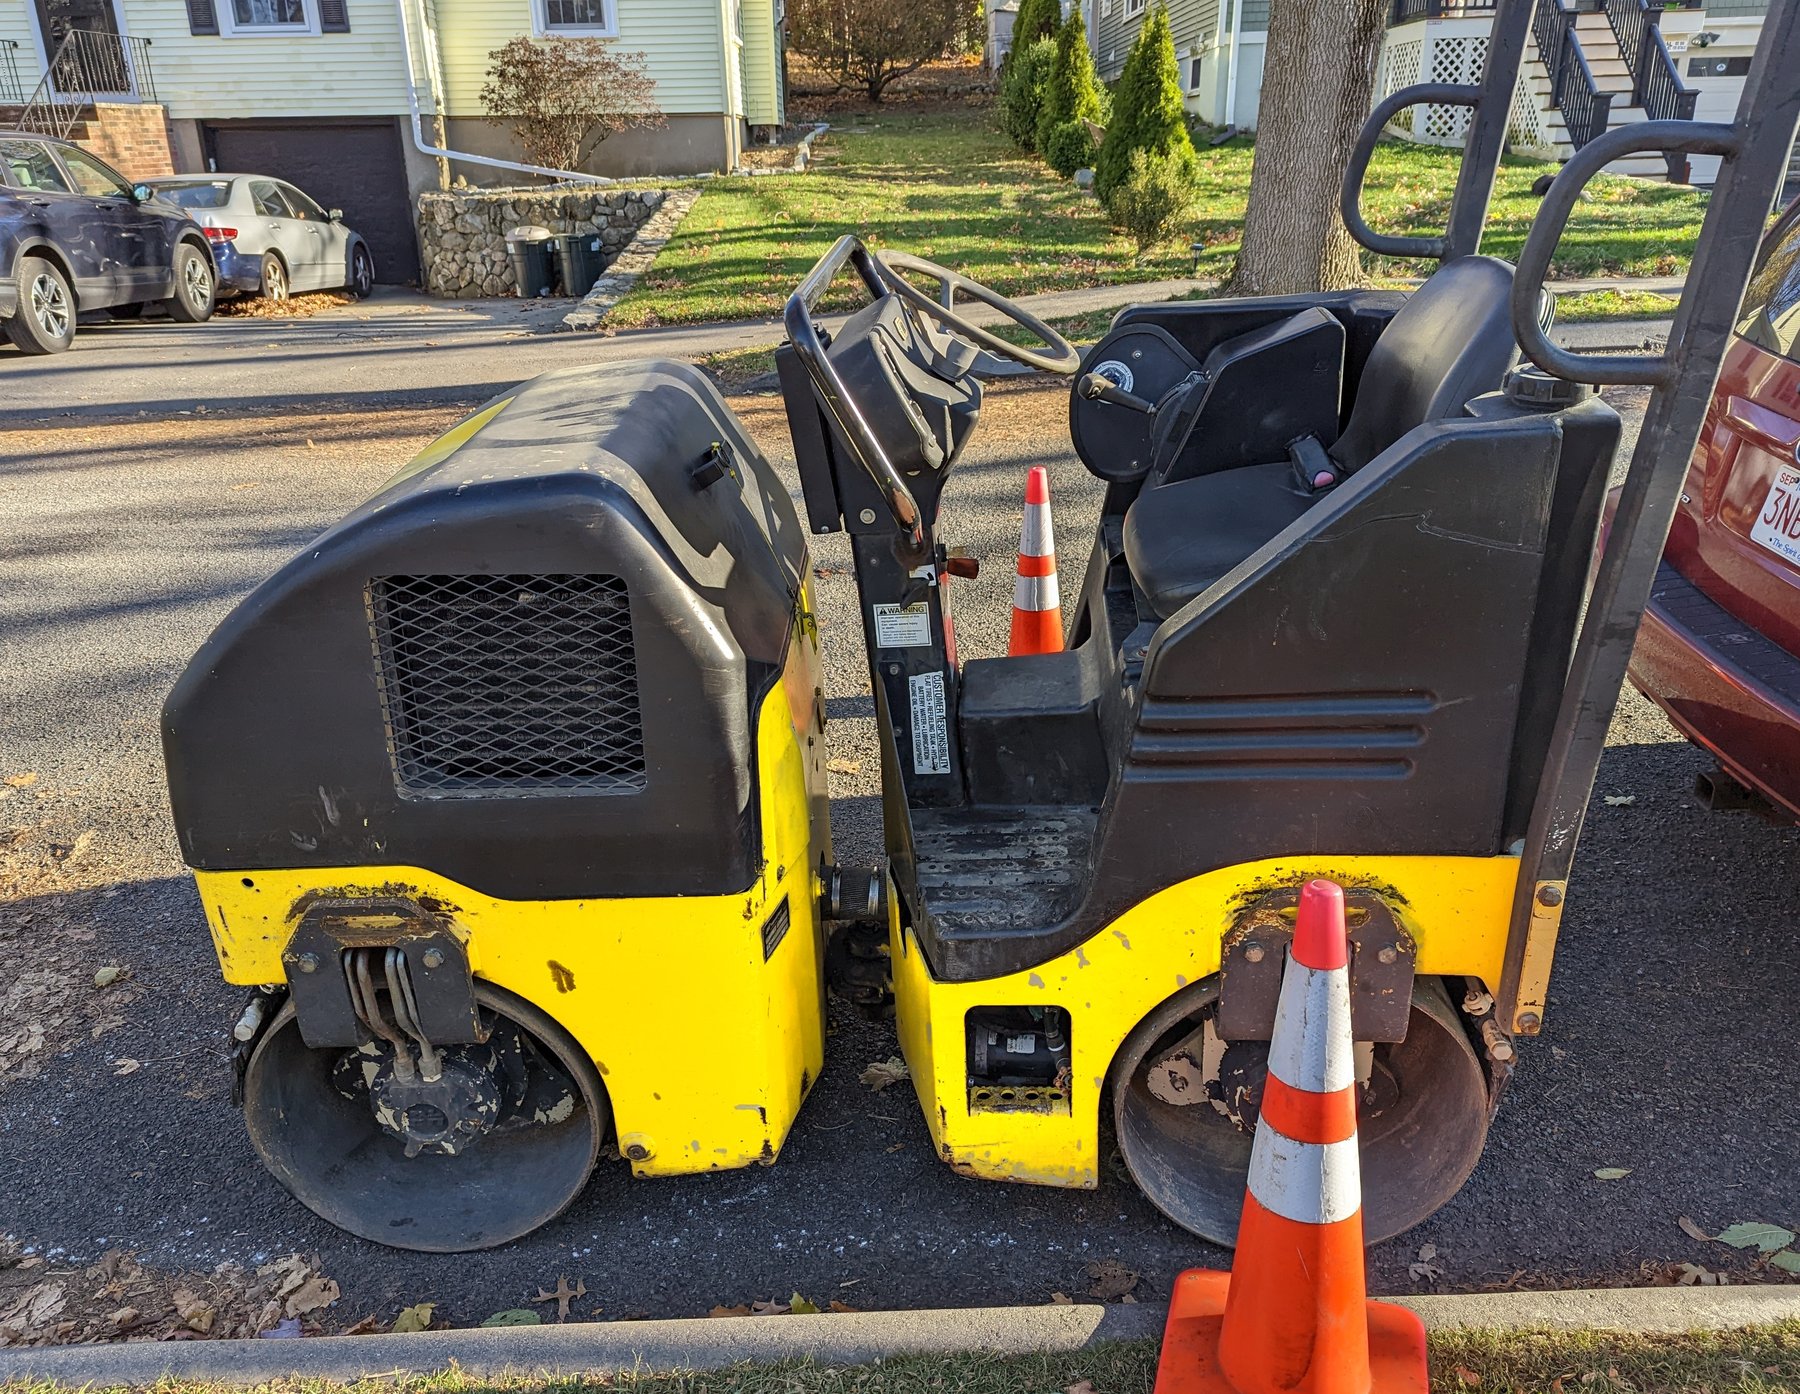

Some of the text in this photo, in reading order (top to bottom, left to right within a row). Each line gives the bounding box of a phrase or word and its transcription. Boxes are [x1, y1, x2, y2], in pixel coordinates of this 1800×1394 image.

[1779, 472, 1795, 487] SEP
[1773, 537, 1782, 550] The
[1783, 543, 1797, 558] Spirit
[927, 706, 935, 732] REFUELING
[933, 675, 948, 769] CUSTOMER RESPONSIBILITY
[915, 739, 923, 767] EQUIPMENT
